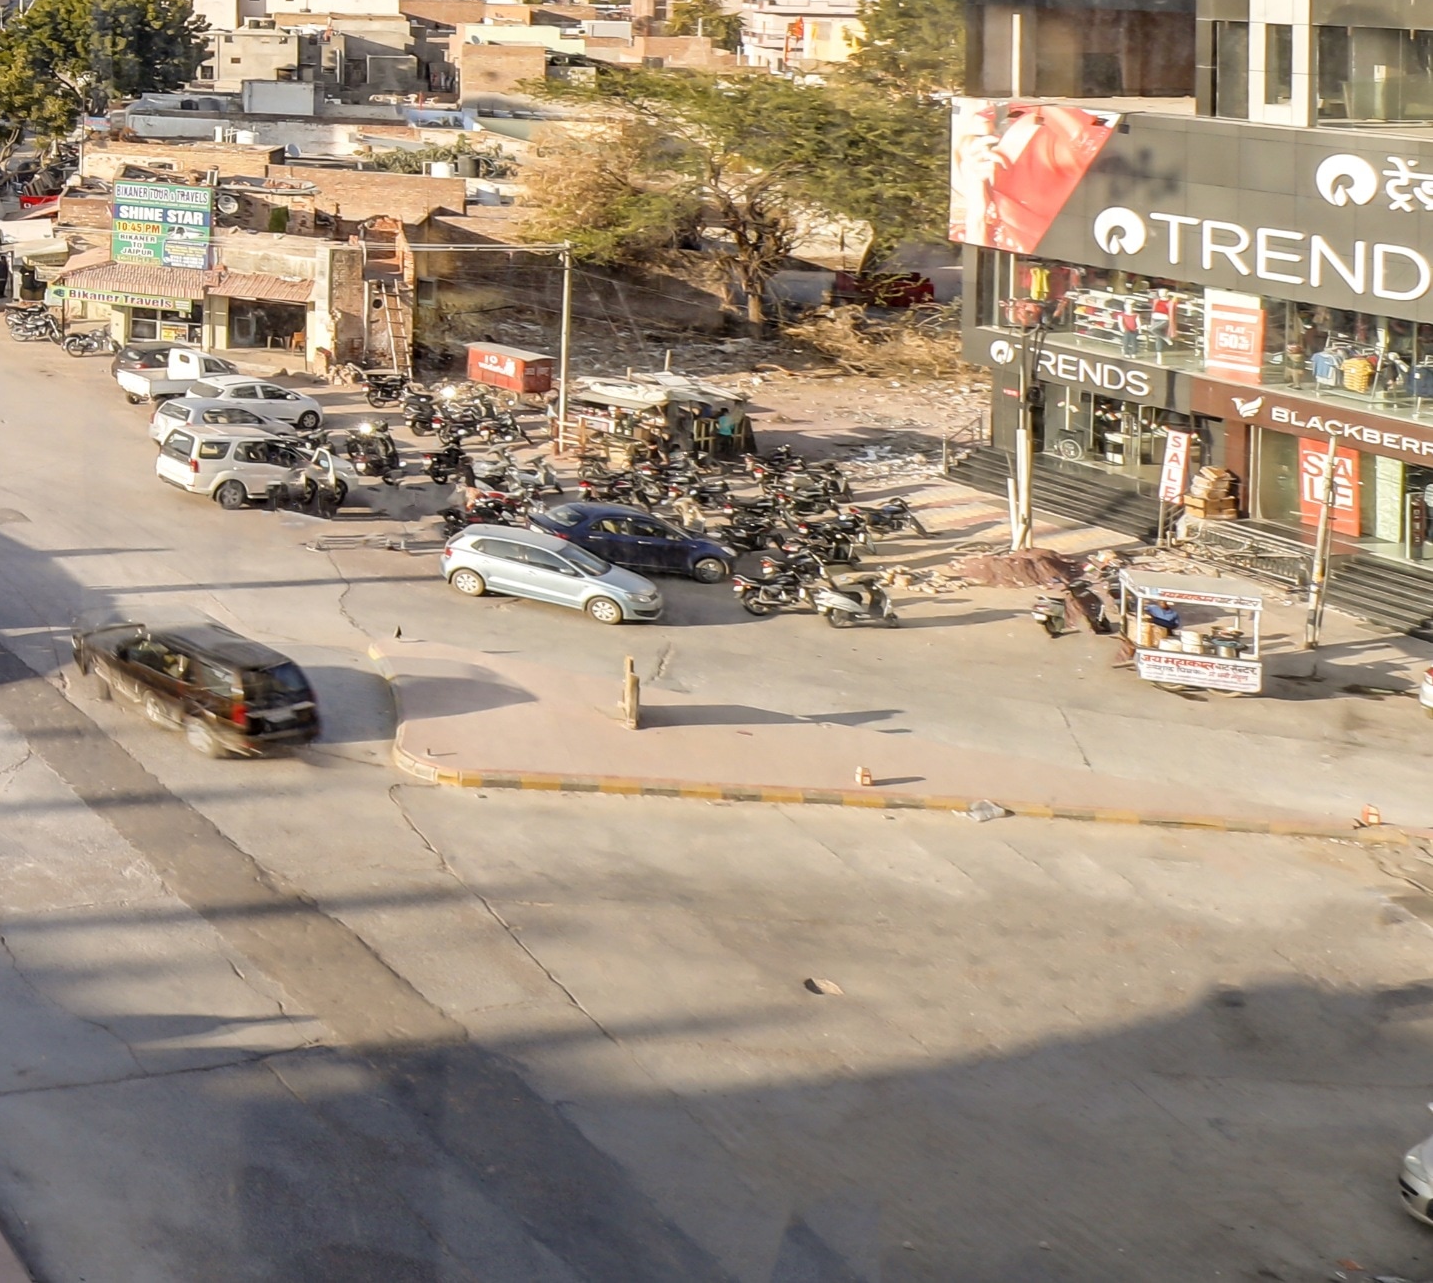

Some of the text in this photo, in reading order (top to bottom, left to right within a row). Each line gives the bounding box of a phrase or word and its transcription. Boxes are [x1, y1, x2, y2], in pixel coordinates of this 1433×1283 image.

[116, 185, 148, 198] BIKANER
[150, 187, 169, 200] TOUR
[176, 189, 208, 204] TRAVELS
[119, 205, 204, 226] SHINE STAR
[117, 221, 161, 234] 10:45 PM
[120, 234, 156, 242] BIKANER
[133, 241, 143, 249] TO
[121, 247, 153, 256] JAIPUR
[1149, 212, 1431, 301] TREND
[68, 288, 173, 309] Bikaner Travels
[1162, 435, 1183, 503] SALE
